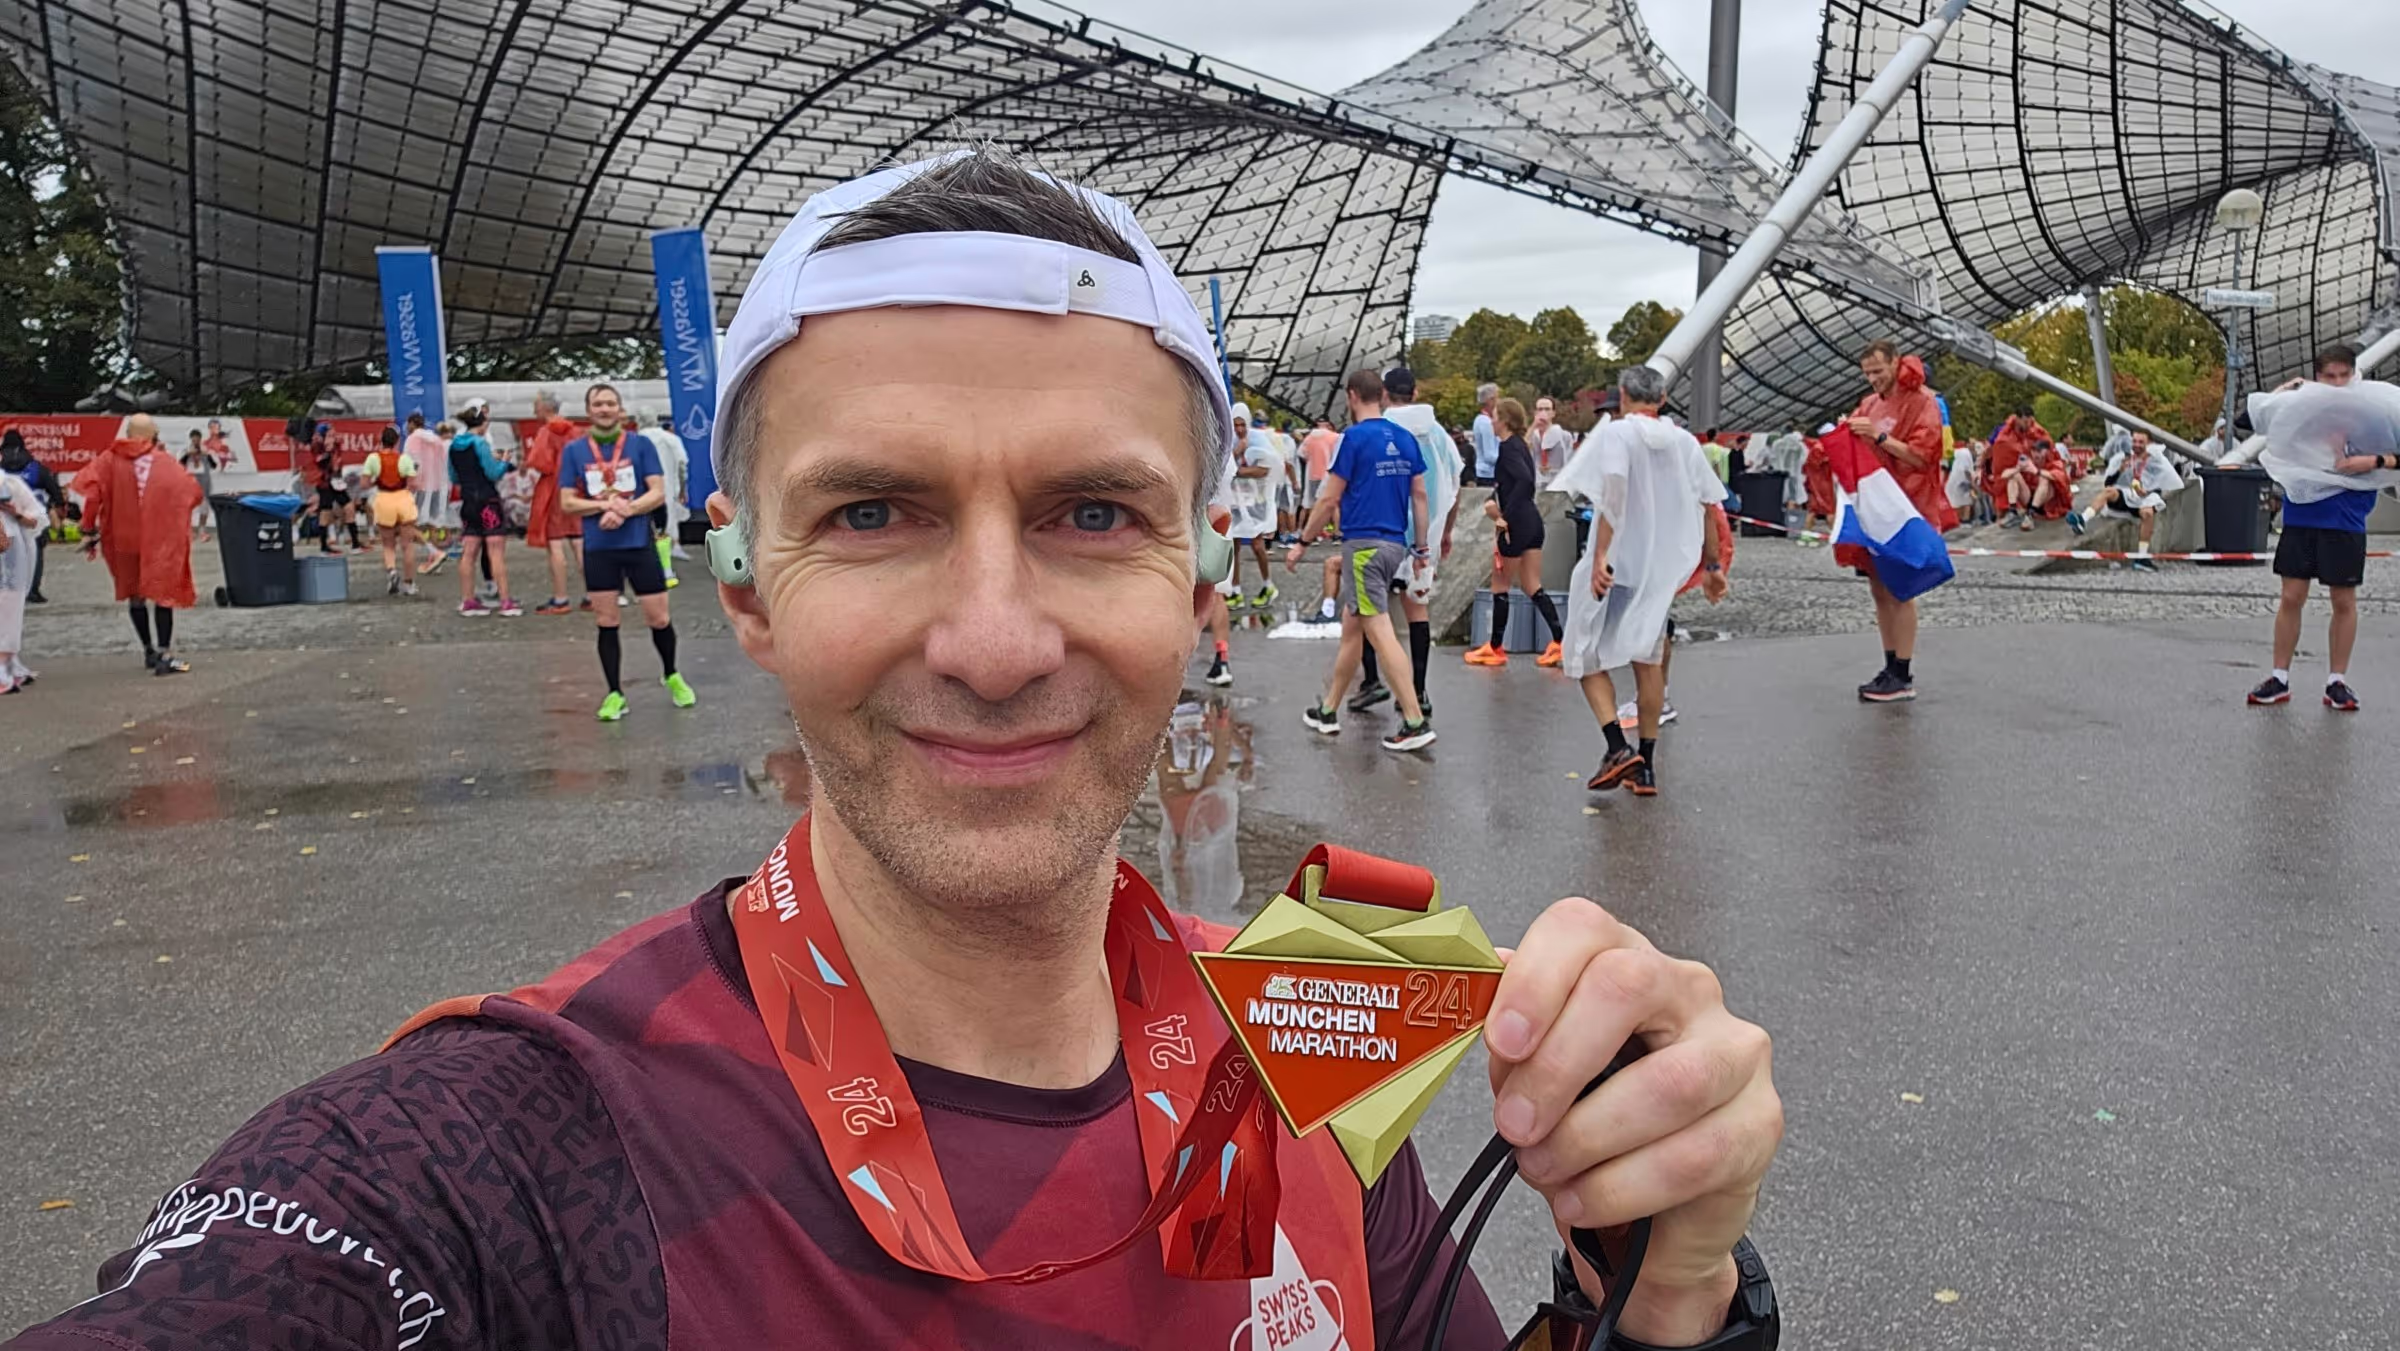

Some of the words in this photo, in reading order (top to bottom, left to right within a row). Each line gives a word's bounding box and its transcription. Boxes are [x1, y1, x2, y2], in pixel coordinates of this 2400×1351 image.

[1247, 1000, 1376, 1034] MÜNCHEN
[1298, 978, 1400, 1009] GENERALI
[1404, 970, 1472, 1030] 24
[1144, 1014, 1197, 1070] 24
[1270, 1029, 1397, 1062] MARATHON
[827, 1076, 897, 1136] 24
[1266, 1305, 1316, 1351] PEAKS
